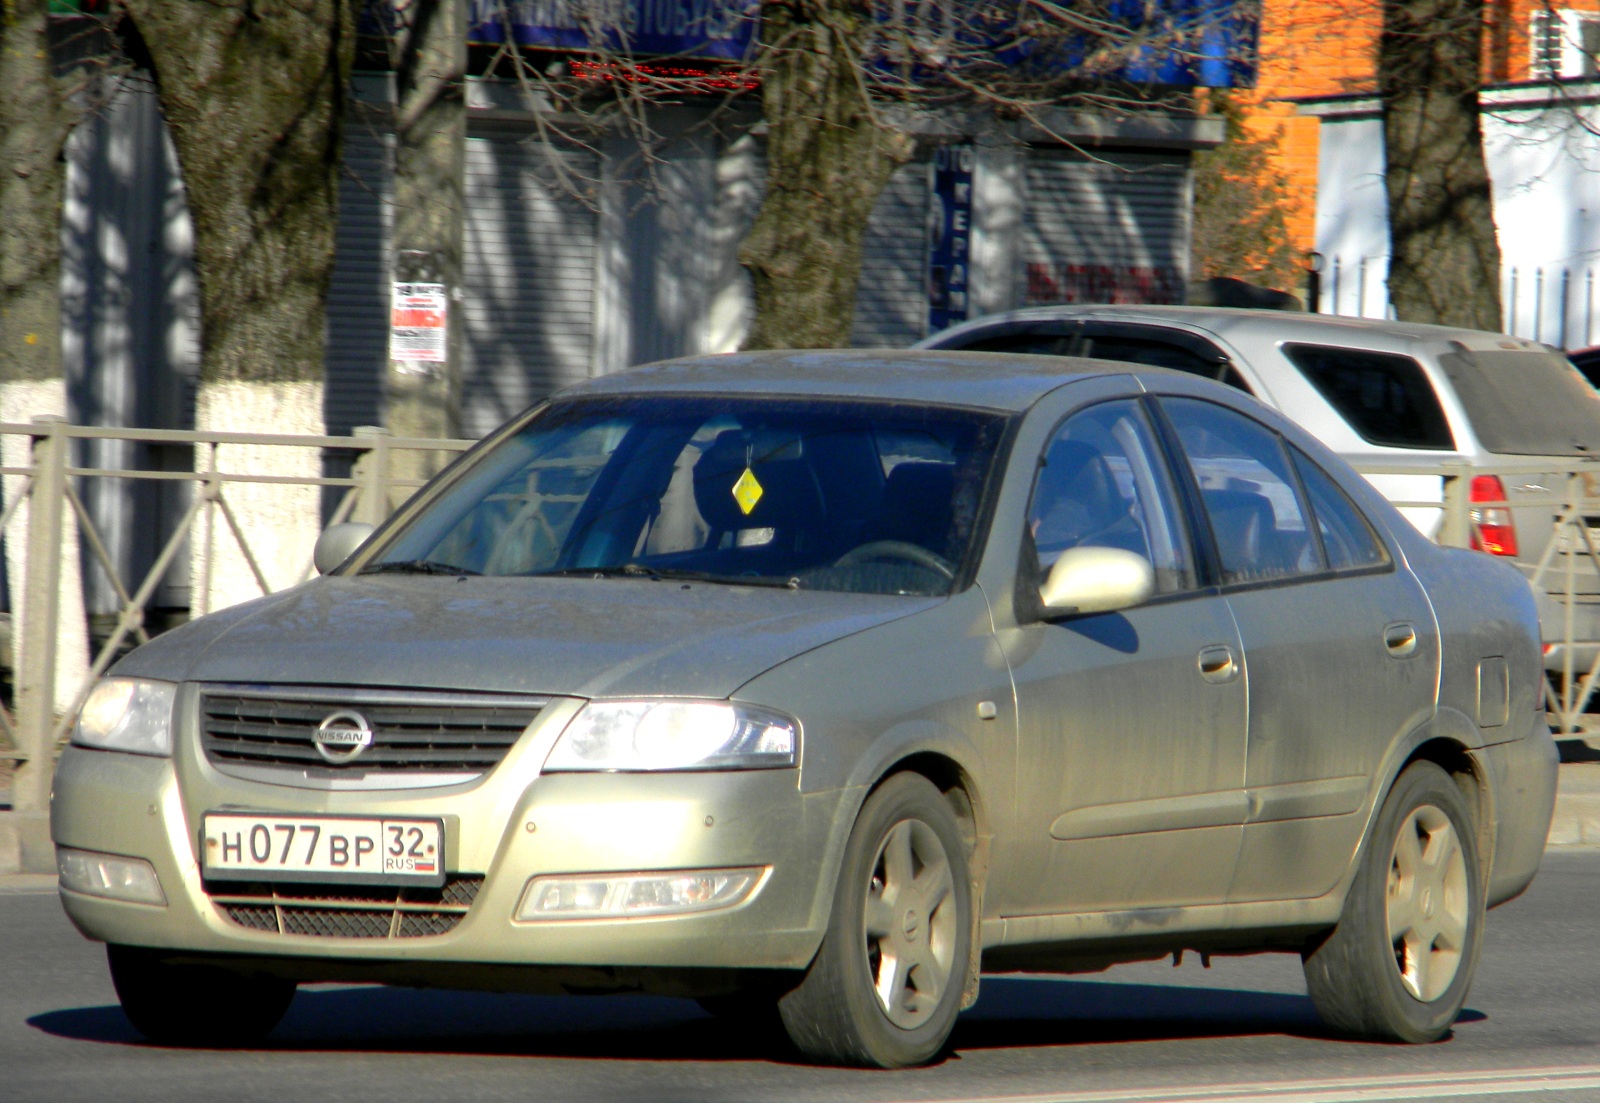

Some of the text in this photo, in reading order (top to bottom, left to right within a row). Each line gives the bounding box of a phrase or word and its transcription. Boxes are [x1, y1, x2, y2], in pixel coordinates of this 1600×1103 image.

[949, 182, 971, 328] КЕРАМ
[315, 730, 363, 743] NISSAN
[387, 826, 424, 857] 32
[386, 858, 414, 870] RUS
